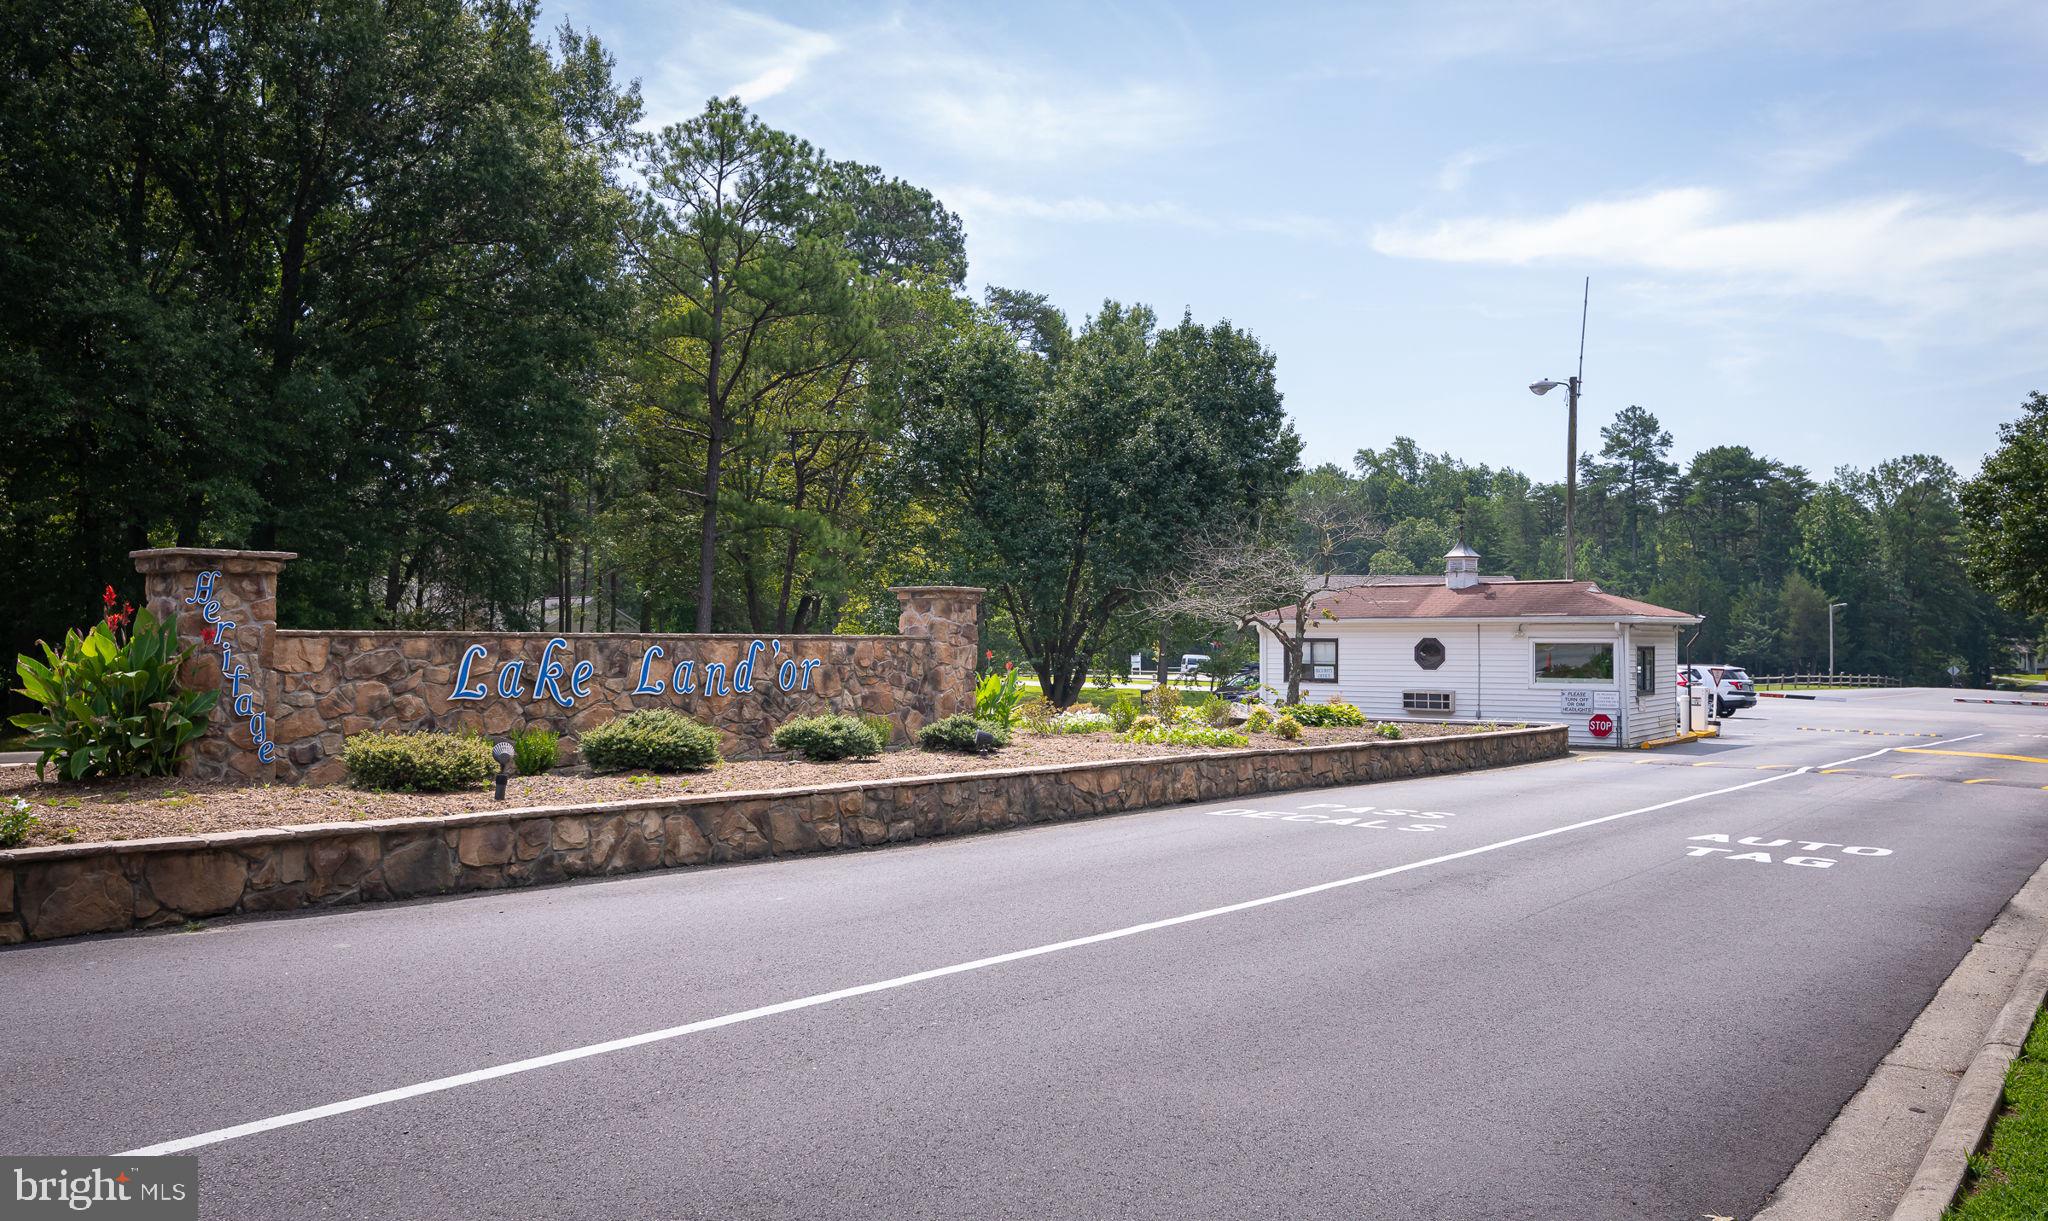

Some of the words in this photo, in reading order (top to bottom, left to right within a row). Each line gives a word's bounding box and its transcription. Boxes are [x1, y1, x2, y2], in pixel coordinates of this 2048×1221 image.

[185, 570, 276, 764] Heritage
[448, 637, 594, 708] Lake
[630, 638, 820, 697] Land'or
[1590, 721, 1612, 730] STOP
[1204, 808, 1448, 832] DECALS
[1297, 803, 1456, 819] PASS
[1686, 833, 1893, 856] AUTO
[1686, 846, 1838, 868] TAG
